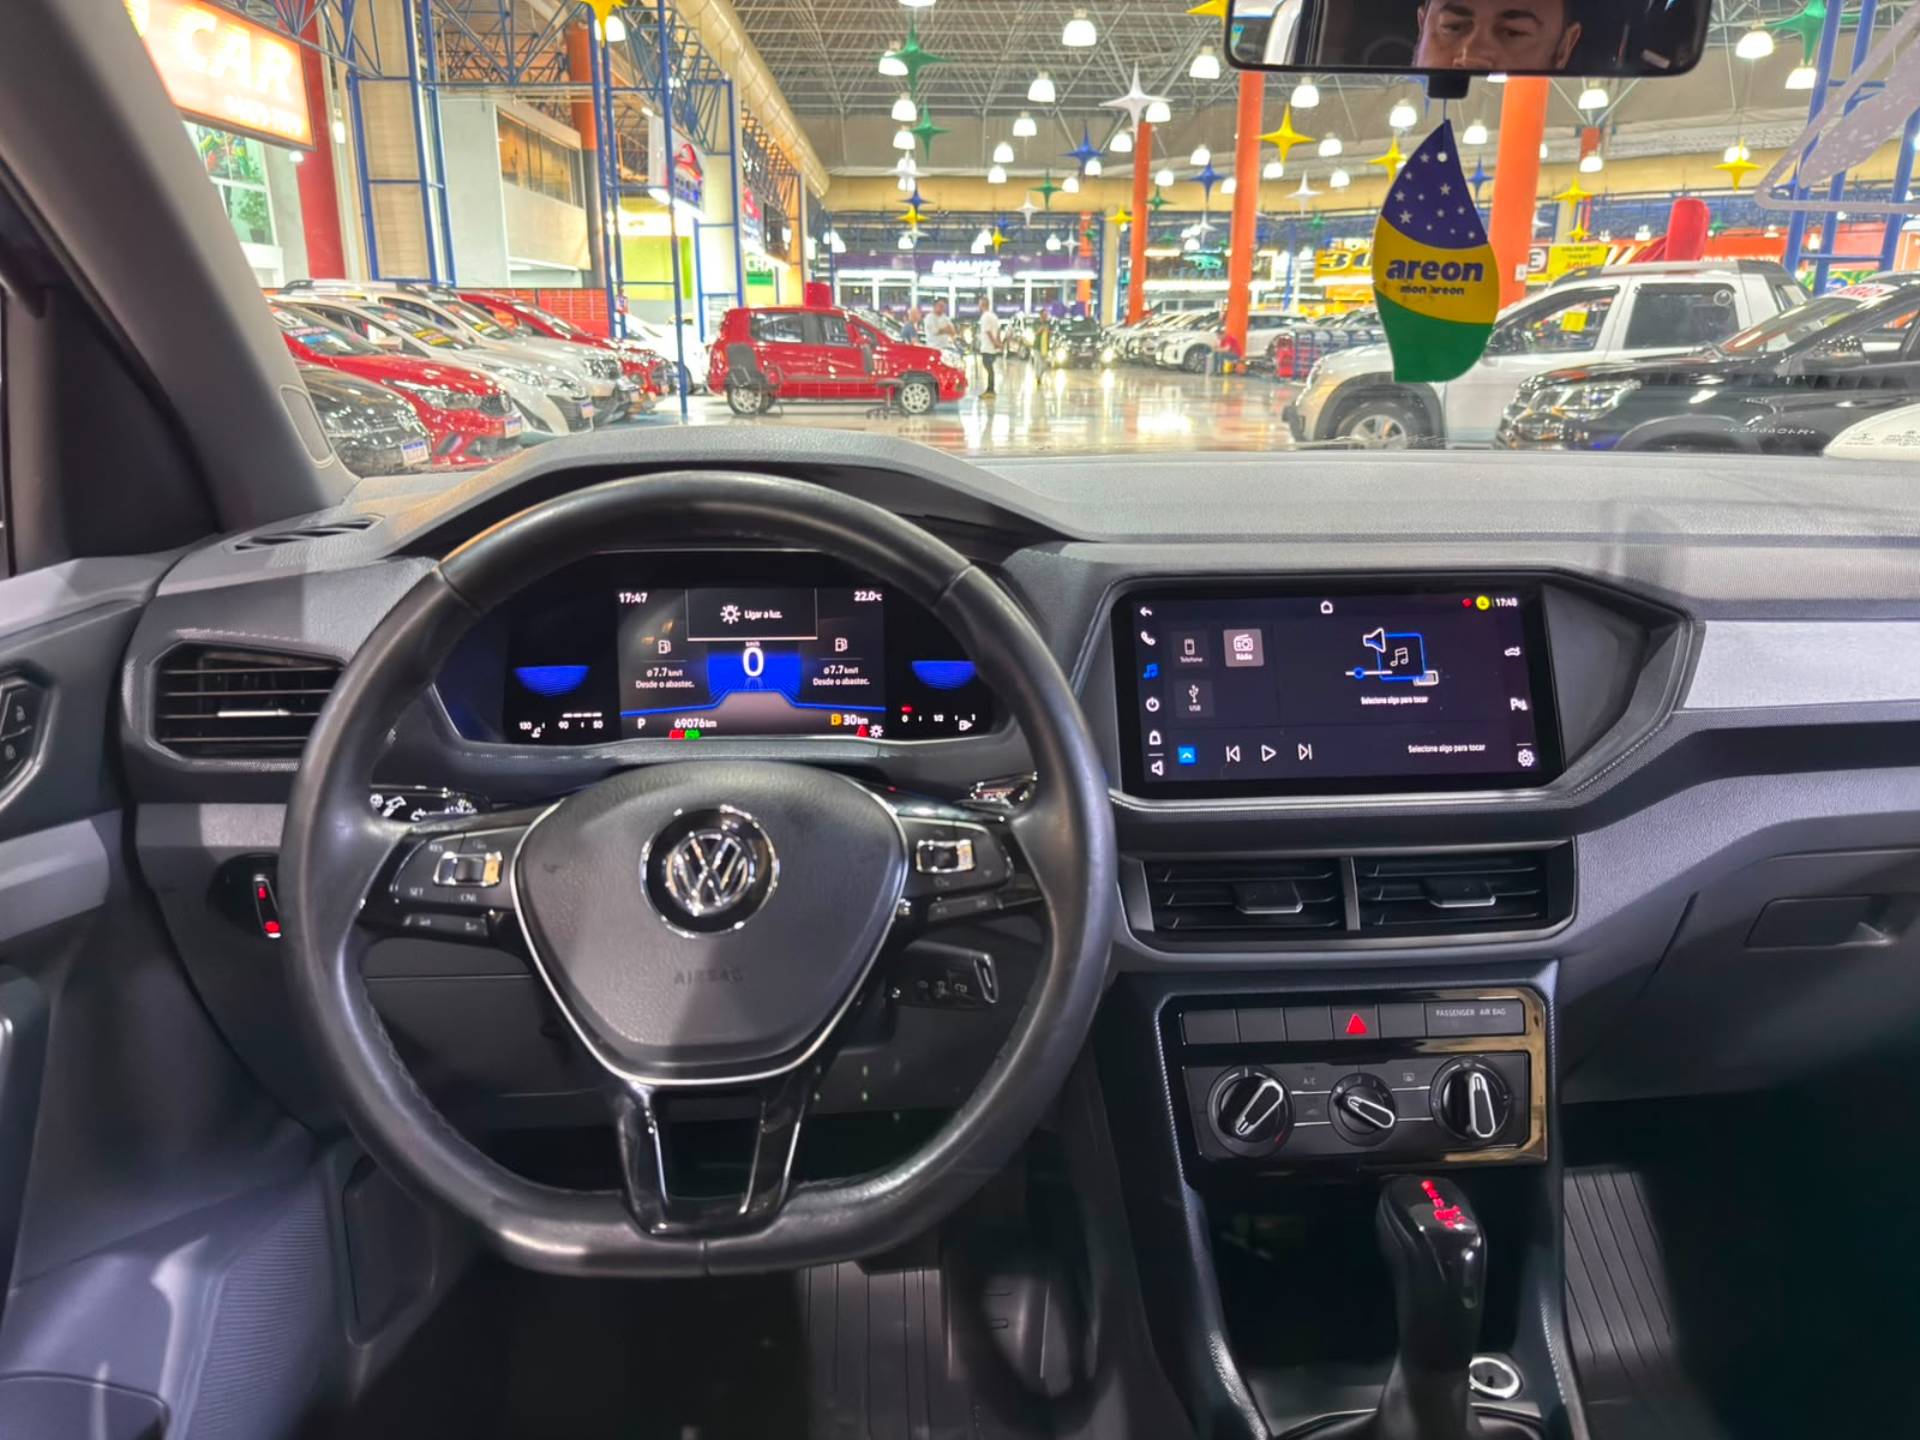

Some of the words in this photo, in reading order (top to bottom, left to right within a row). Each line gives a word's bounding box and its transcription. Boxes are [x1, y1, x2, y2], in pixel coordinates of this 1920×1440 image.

[167, 5, 295, 102] CAR
[1386, 260, 1484, 282] areon
[619, 592, 648, 604] 17:47
[743, 646, 764, 677] 0
[635, 680, 658, 689] Desde
[812, 677, 835, 686] Desde
[637, 717, 646, 730] P
[1408, 744, 1438, 754] Selecione
[1439, 744, 1453, 754] algo
[1453, 745, 1468, 754] para
[1468, 744, 1486, 752] tocar
[409, 887, 424, 897] SET
[1436, 1008, 1475, 1017] PASSENGER
[1303, 1077, 1316, 1086] A/C
